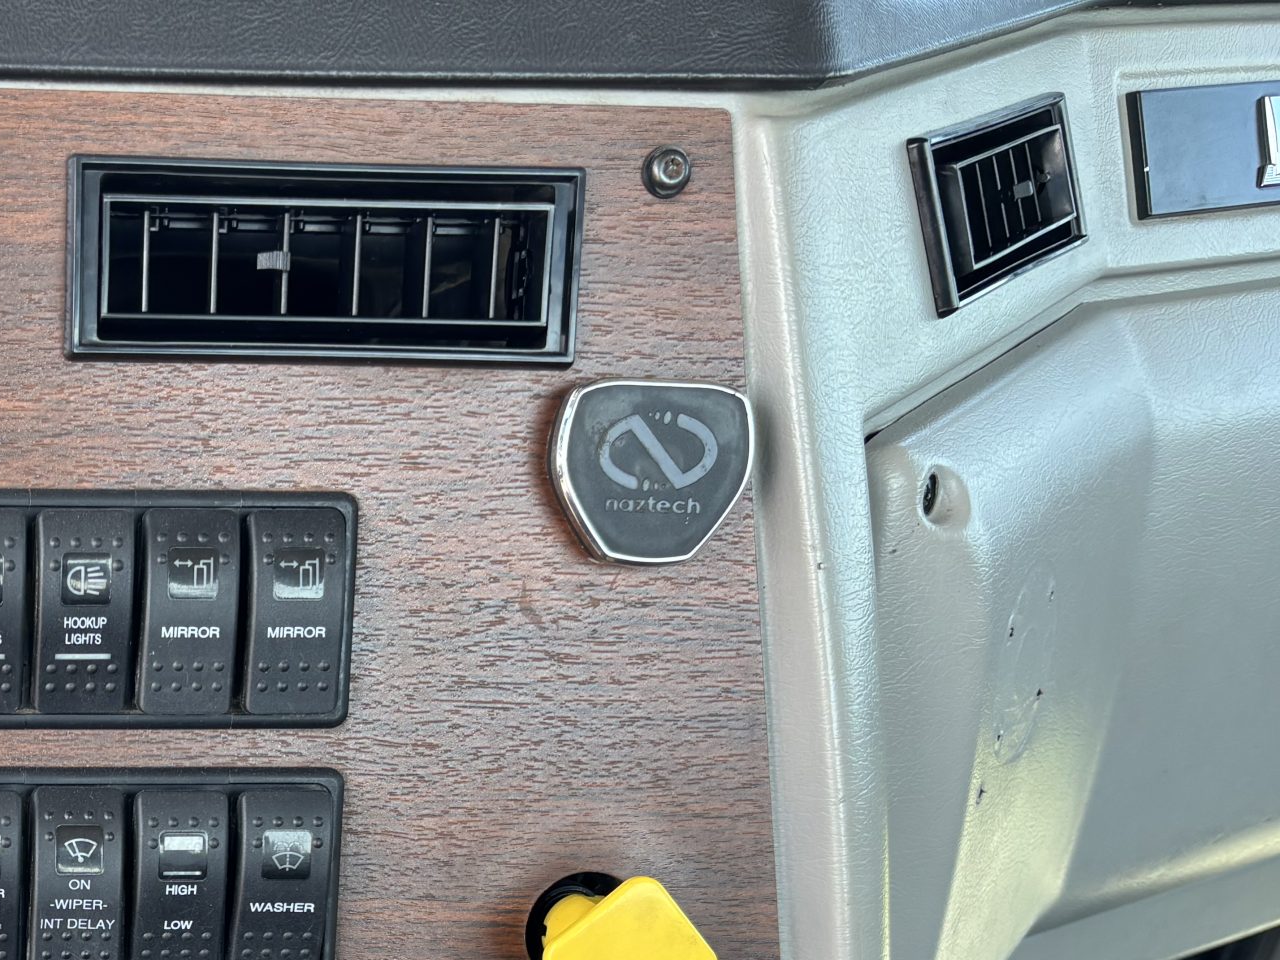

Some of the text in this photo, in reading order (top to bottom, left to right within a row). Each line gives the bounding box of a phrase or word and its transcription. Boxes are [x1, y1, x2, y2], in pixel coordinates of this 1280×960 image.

[605, 496, 700, 514] naztech
[63, 617, 107, 630] HOOKUP
[65, 631, 102, 646] LIGHTS
[161, 626, 220, 639] MIRROR
[267, 626, 326, 639] MIRROR
[68, 879, 91, 891] ON
[165, 884, 197, 896] HIGH
[249, 902, 315, 913] WASHER
[40, 918, 115, 931] INT DELAY
[163, 920, 193, 931] LOW
